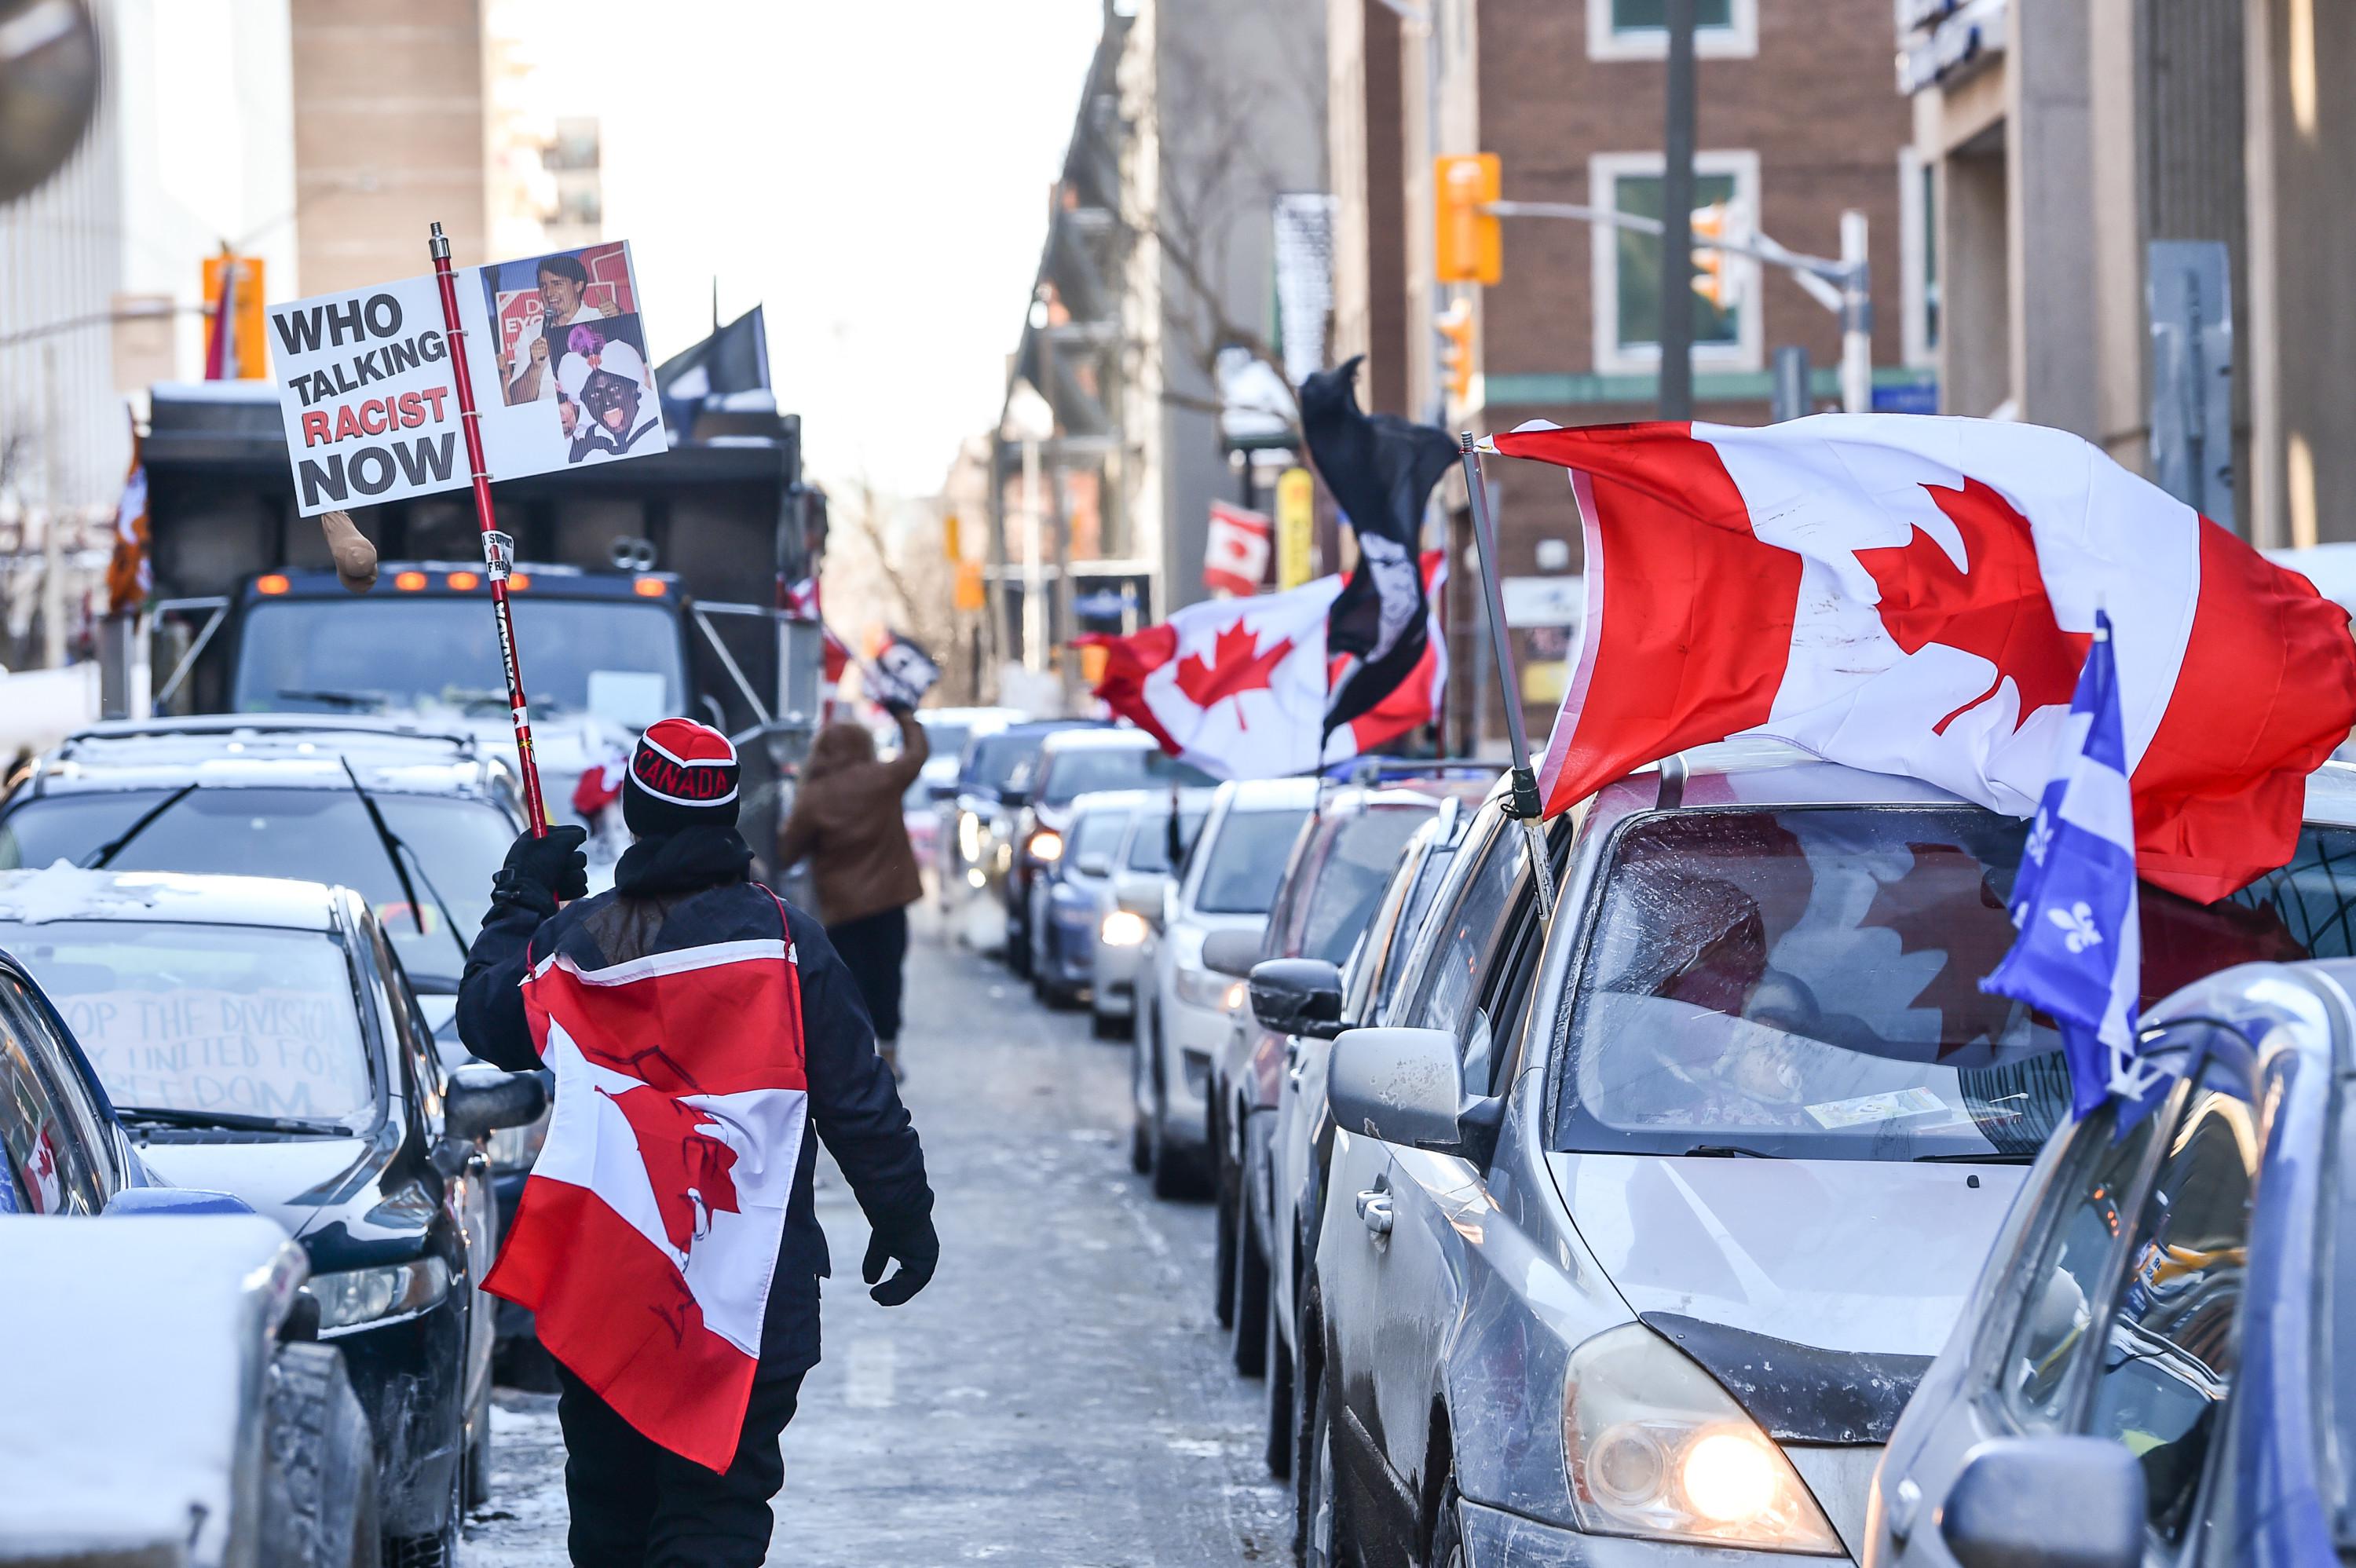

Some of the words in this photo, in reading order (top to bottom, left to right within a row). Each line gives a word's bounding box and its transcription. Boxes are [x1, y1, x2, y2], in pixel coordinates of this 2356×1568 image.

[273, 294, 402, 355] WHO
[288, 331, 448, 407] TALKING
[302, 386, 448, 448] RACIST
[298, 432, 455, 507] NOW
[635, 749, 728, 799] CANADA
[57, 1000, 118, 1039] OP
[133, 998, 202, 1040] THE
[128, 1036, 260, 1073] UNITED
[102, 1072, 313, 1116] REEDOM
